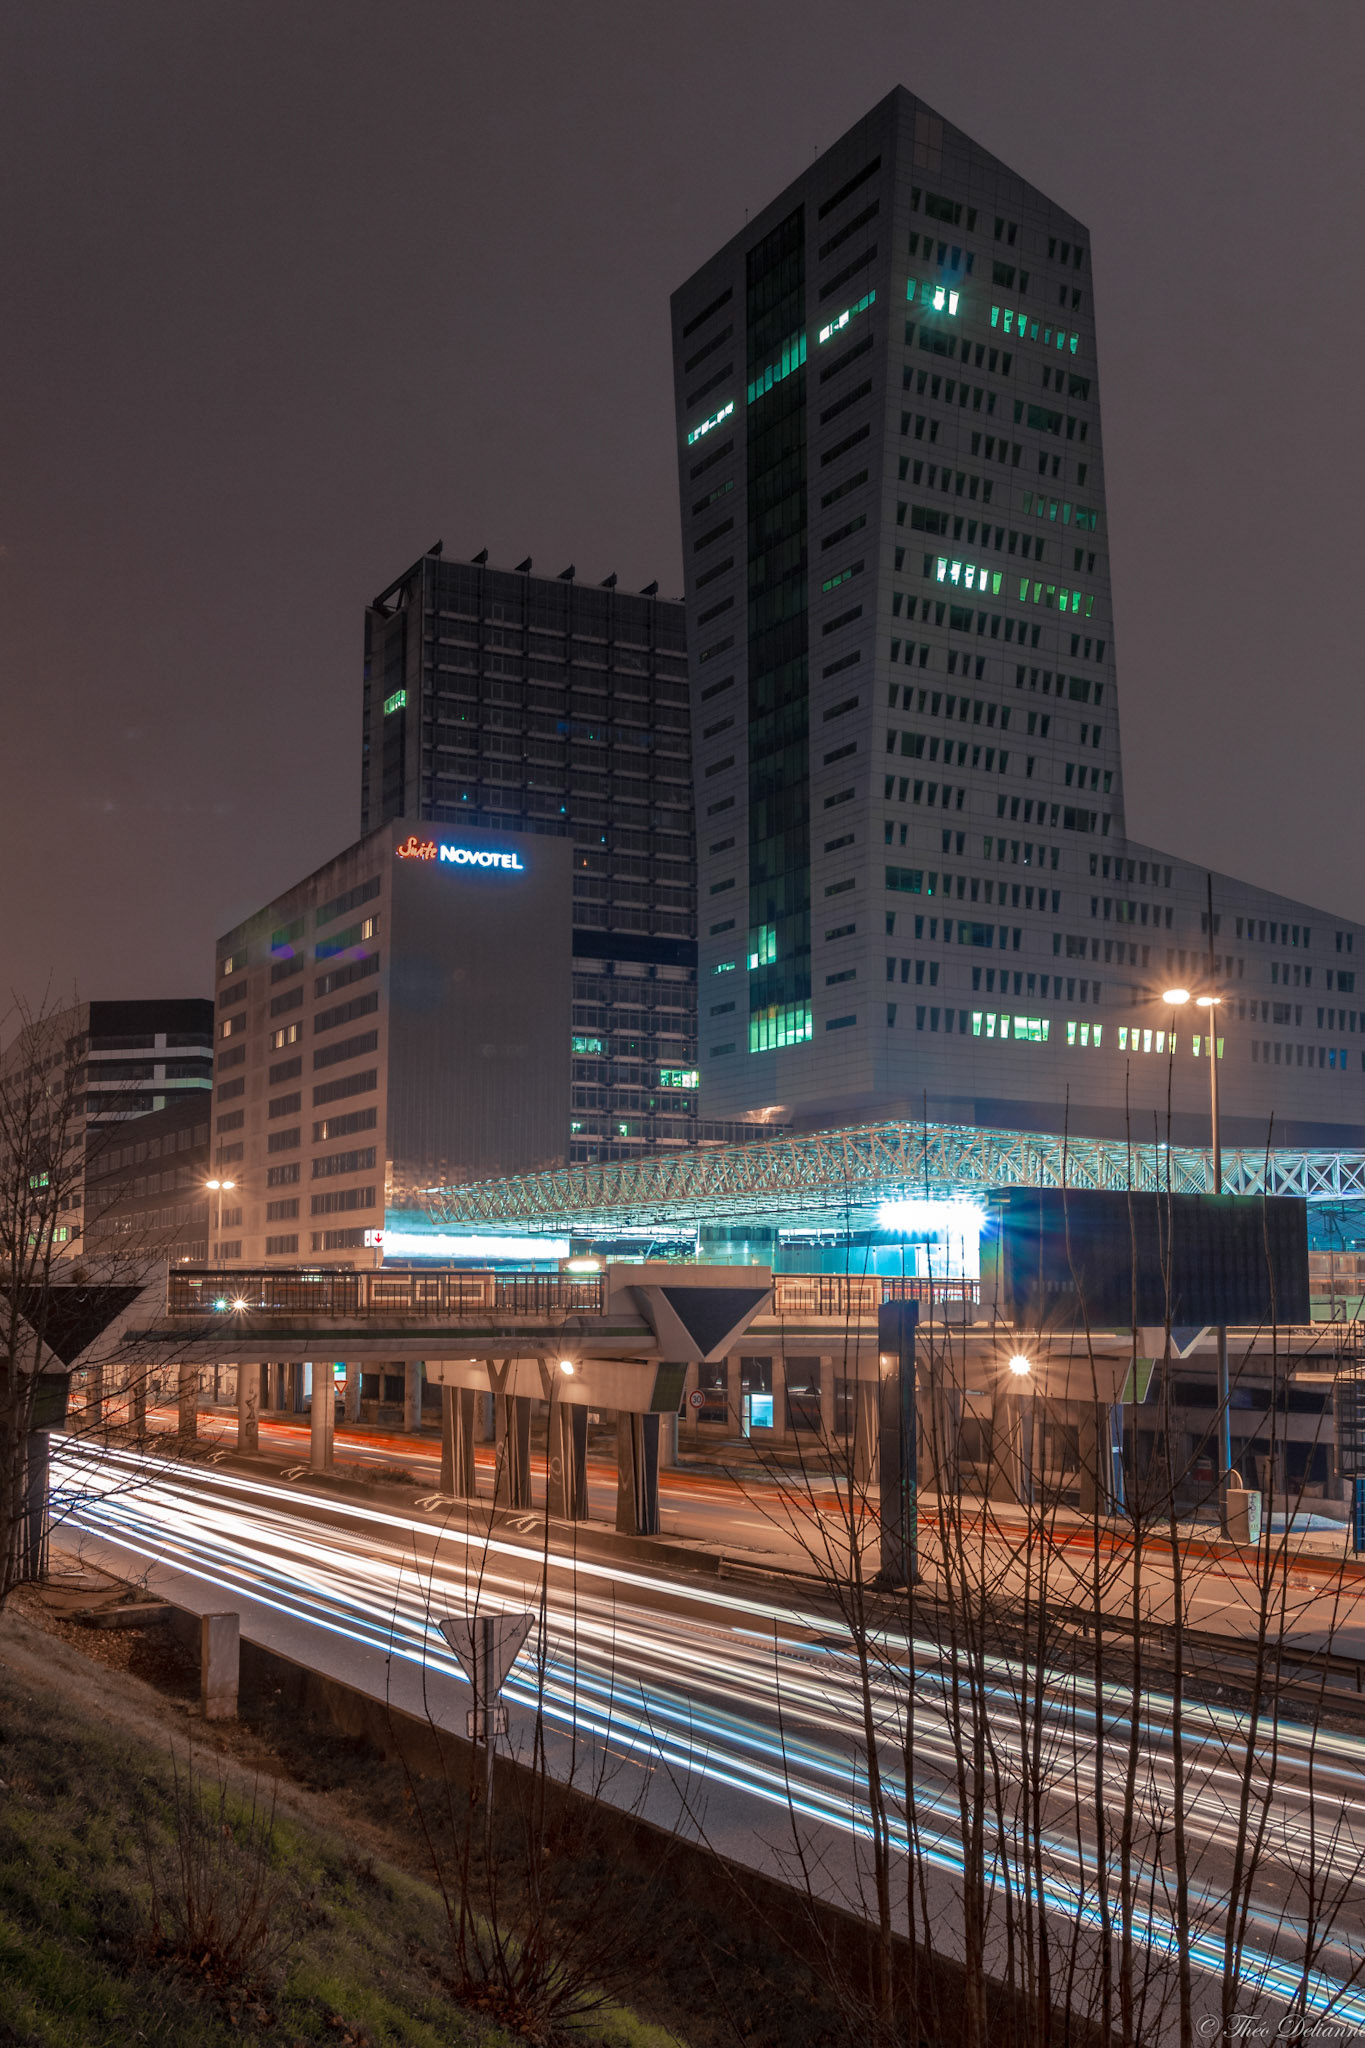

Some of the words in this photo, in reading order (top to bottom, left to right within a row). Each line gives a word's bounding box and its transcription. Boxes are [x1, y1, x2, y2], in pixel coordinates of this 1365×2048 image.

[398, 837, 437, 860] Suite
[440, 845, 524, 869] NOVOTEL
[692, 1395, 702, 1404] 30
